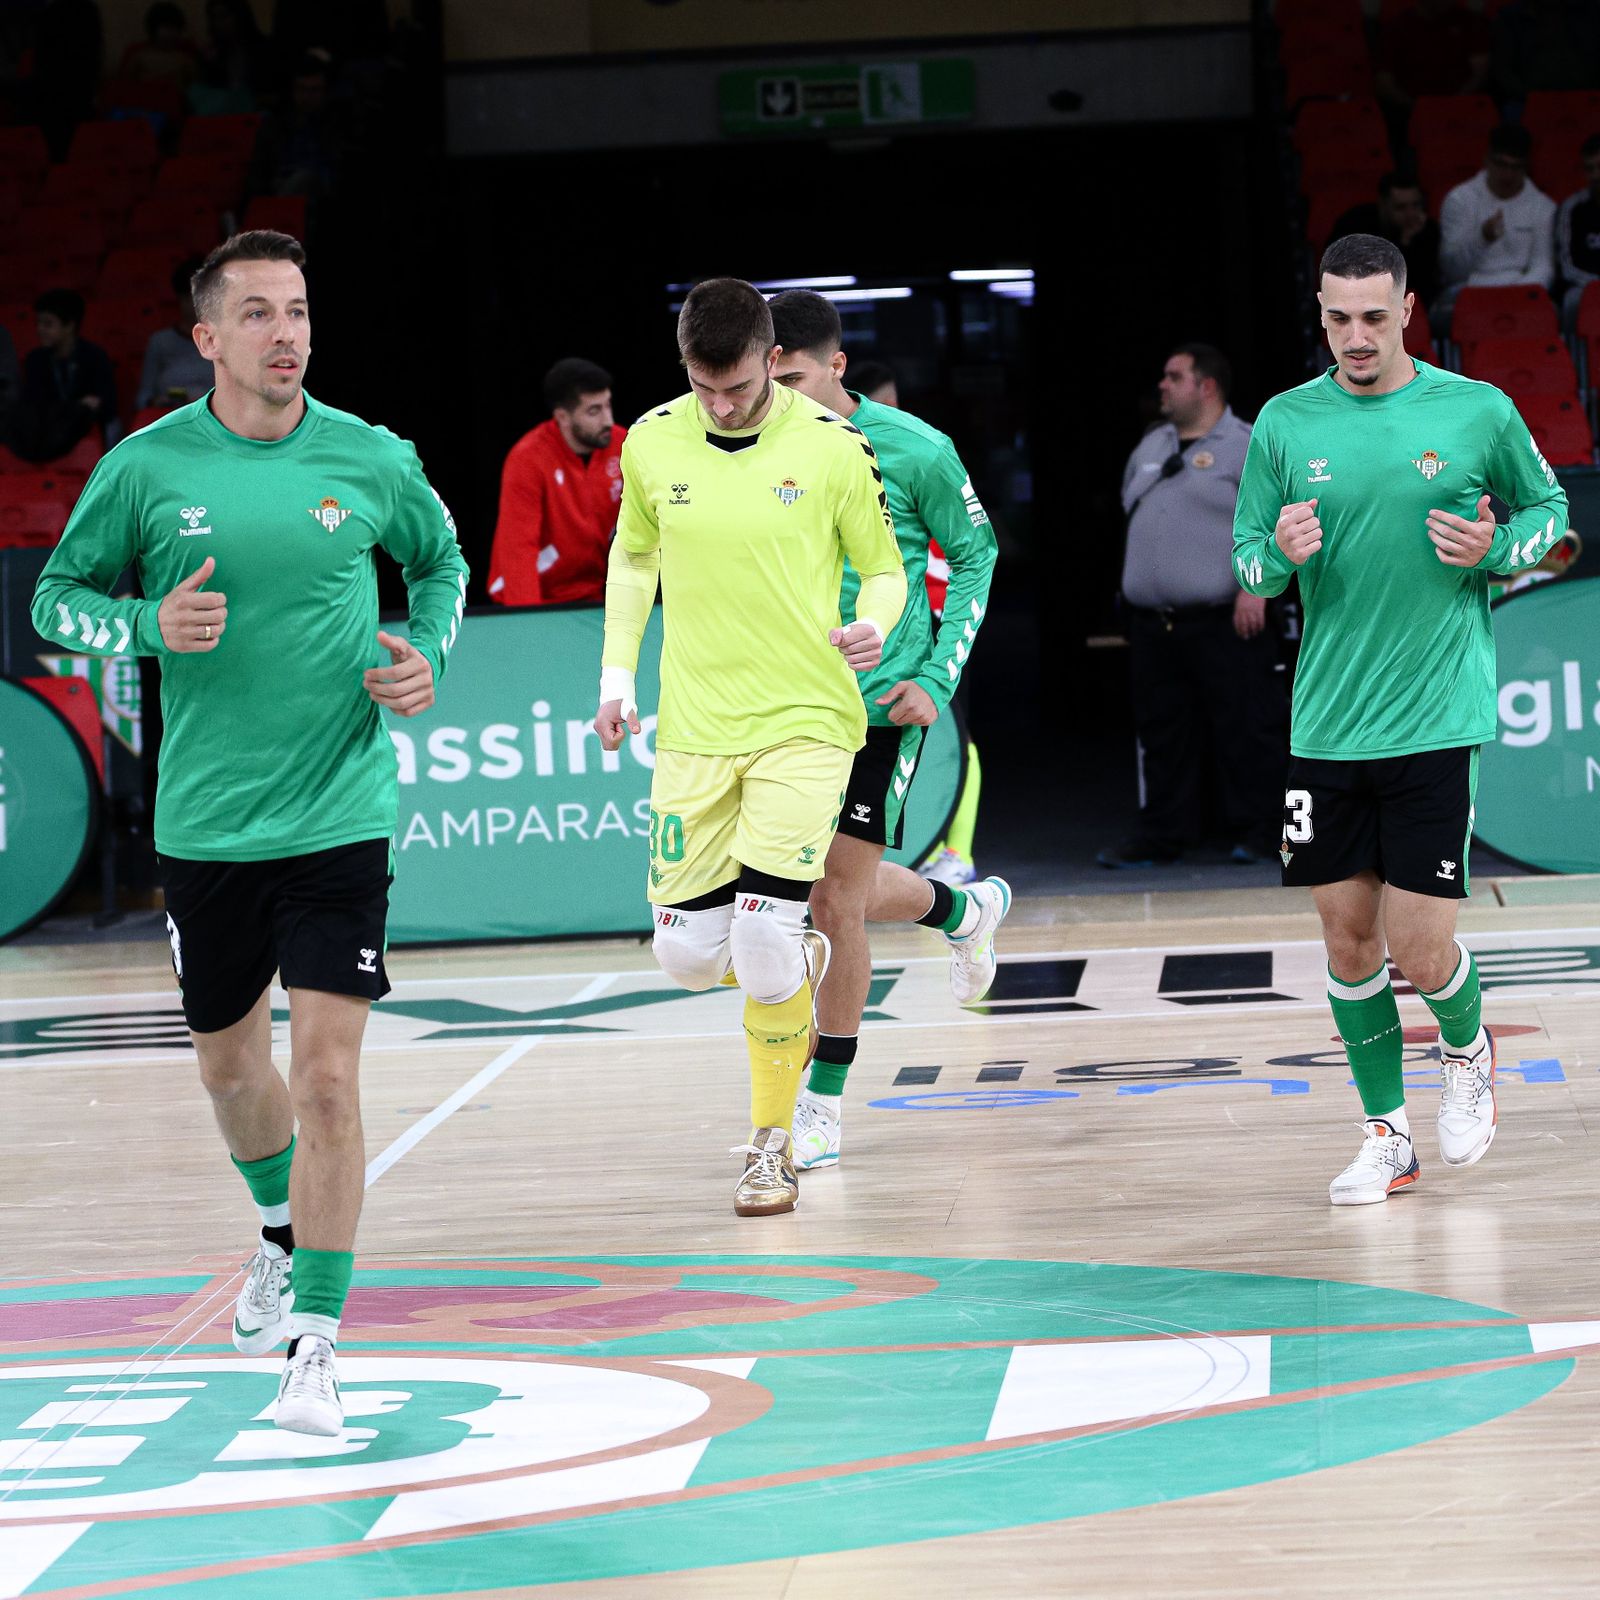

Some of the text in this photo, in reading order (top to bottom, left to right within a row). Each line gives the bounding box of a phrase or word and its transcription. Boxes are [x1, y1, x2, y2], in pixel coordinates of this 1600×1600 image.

[1307, 473, 1332, 483] hummel
[178, 525, 212, 537] hummel
[1497, 660, 1600, 747] gl
[400, 798, 652, 850] AMPARAS
